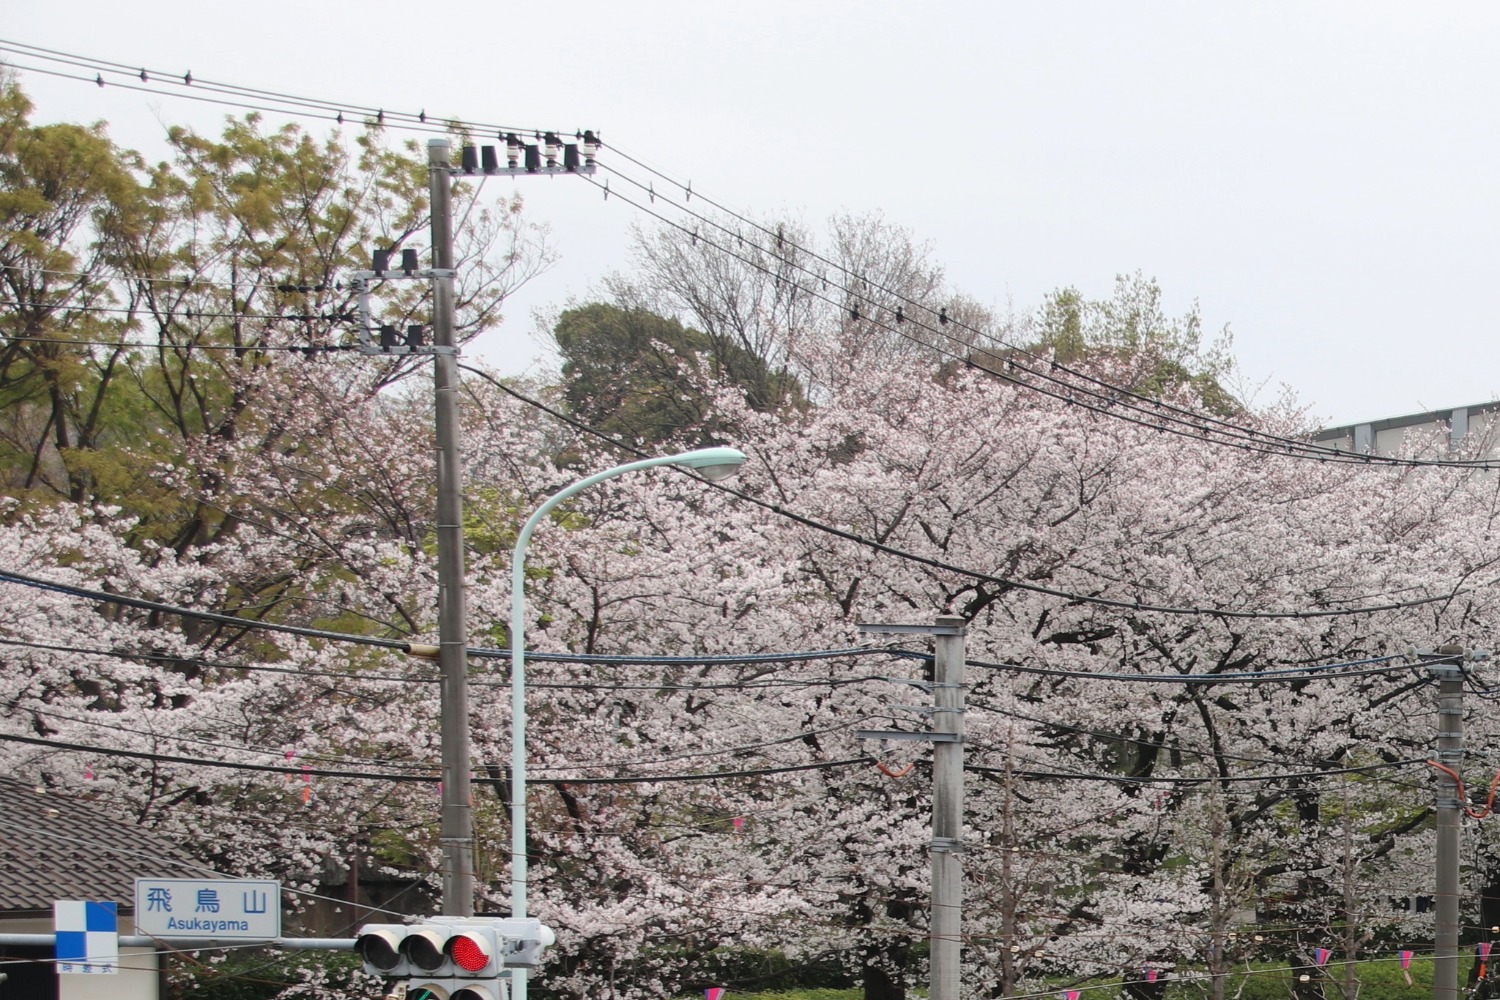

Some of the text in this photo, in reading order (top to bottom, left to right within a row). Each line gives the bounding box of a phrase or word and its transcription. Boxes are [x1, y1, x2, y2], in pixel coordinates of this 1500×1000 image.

[147, 887, 266, 914] 飛鳥山
[168, 917, 249, 933] Asukayama
